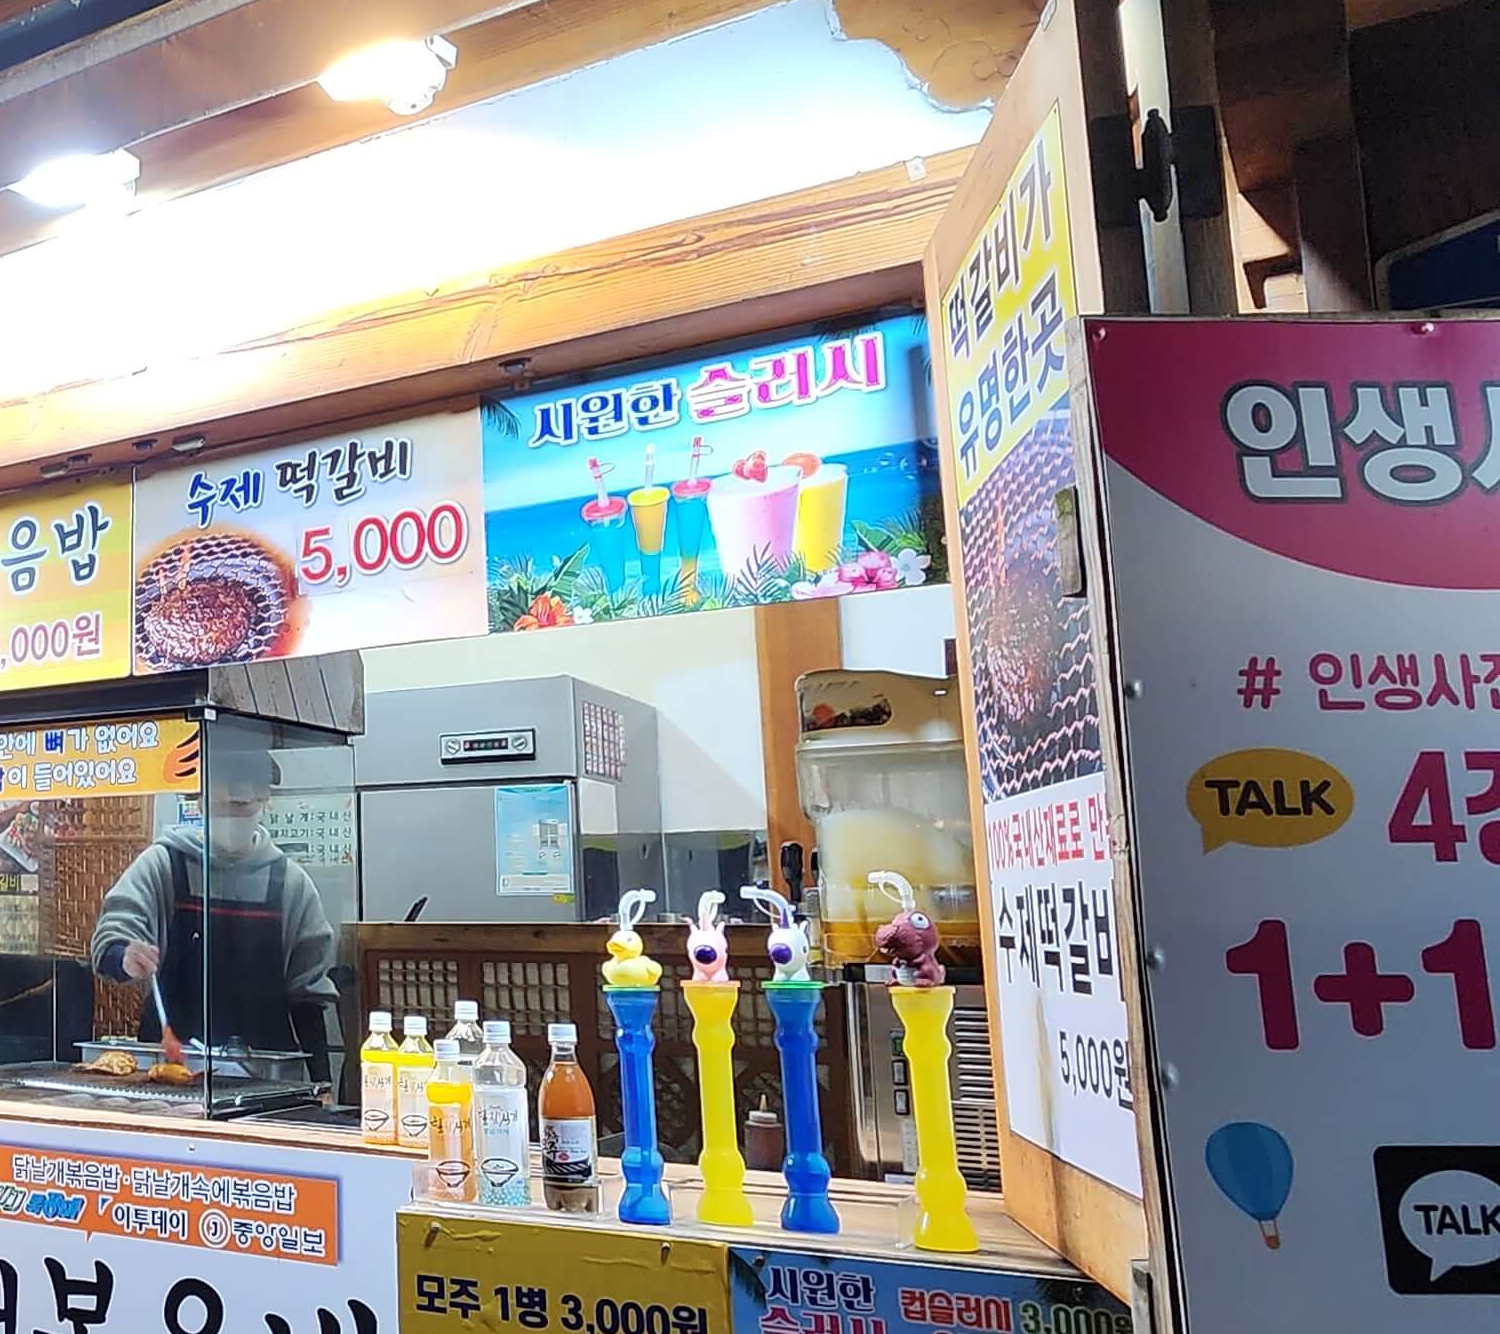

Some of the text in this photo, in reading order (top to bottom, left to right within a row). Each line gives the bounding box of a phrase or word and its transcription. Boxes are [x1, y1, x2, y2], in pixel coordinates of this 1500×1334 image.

[948, 138, 1052, 360] 떡갈비가
[531, 331, 886, 447] 시원한 슬러시
[187, 437, 413, 526] 수제 떡갈비
[299, 503, 466, 583] 5,000
[95, 721, 159, 752] 없어요
[1204, 779, 1335, 816] TALK
[1225, 918, 1497, 1050] 1+1
[114, 1204, 189, 1238] 이투데이
[233, 1220, 325, 1255] 중앙일보
[1413, 1203, 1500, 1237] TALK
[416, 1274, 481, 1319] 모주
[494, 1285, 548, 1330] 1병
[768, 1267, 874, 1314] 시원한
[900, 1288, 1012, 1334] 컵슬러시
